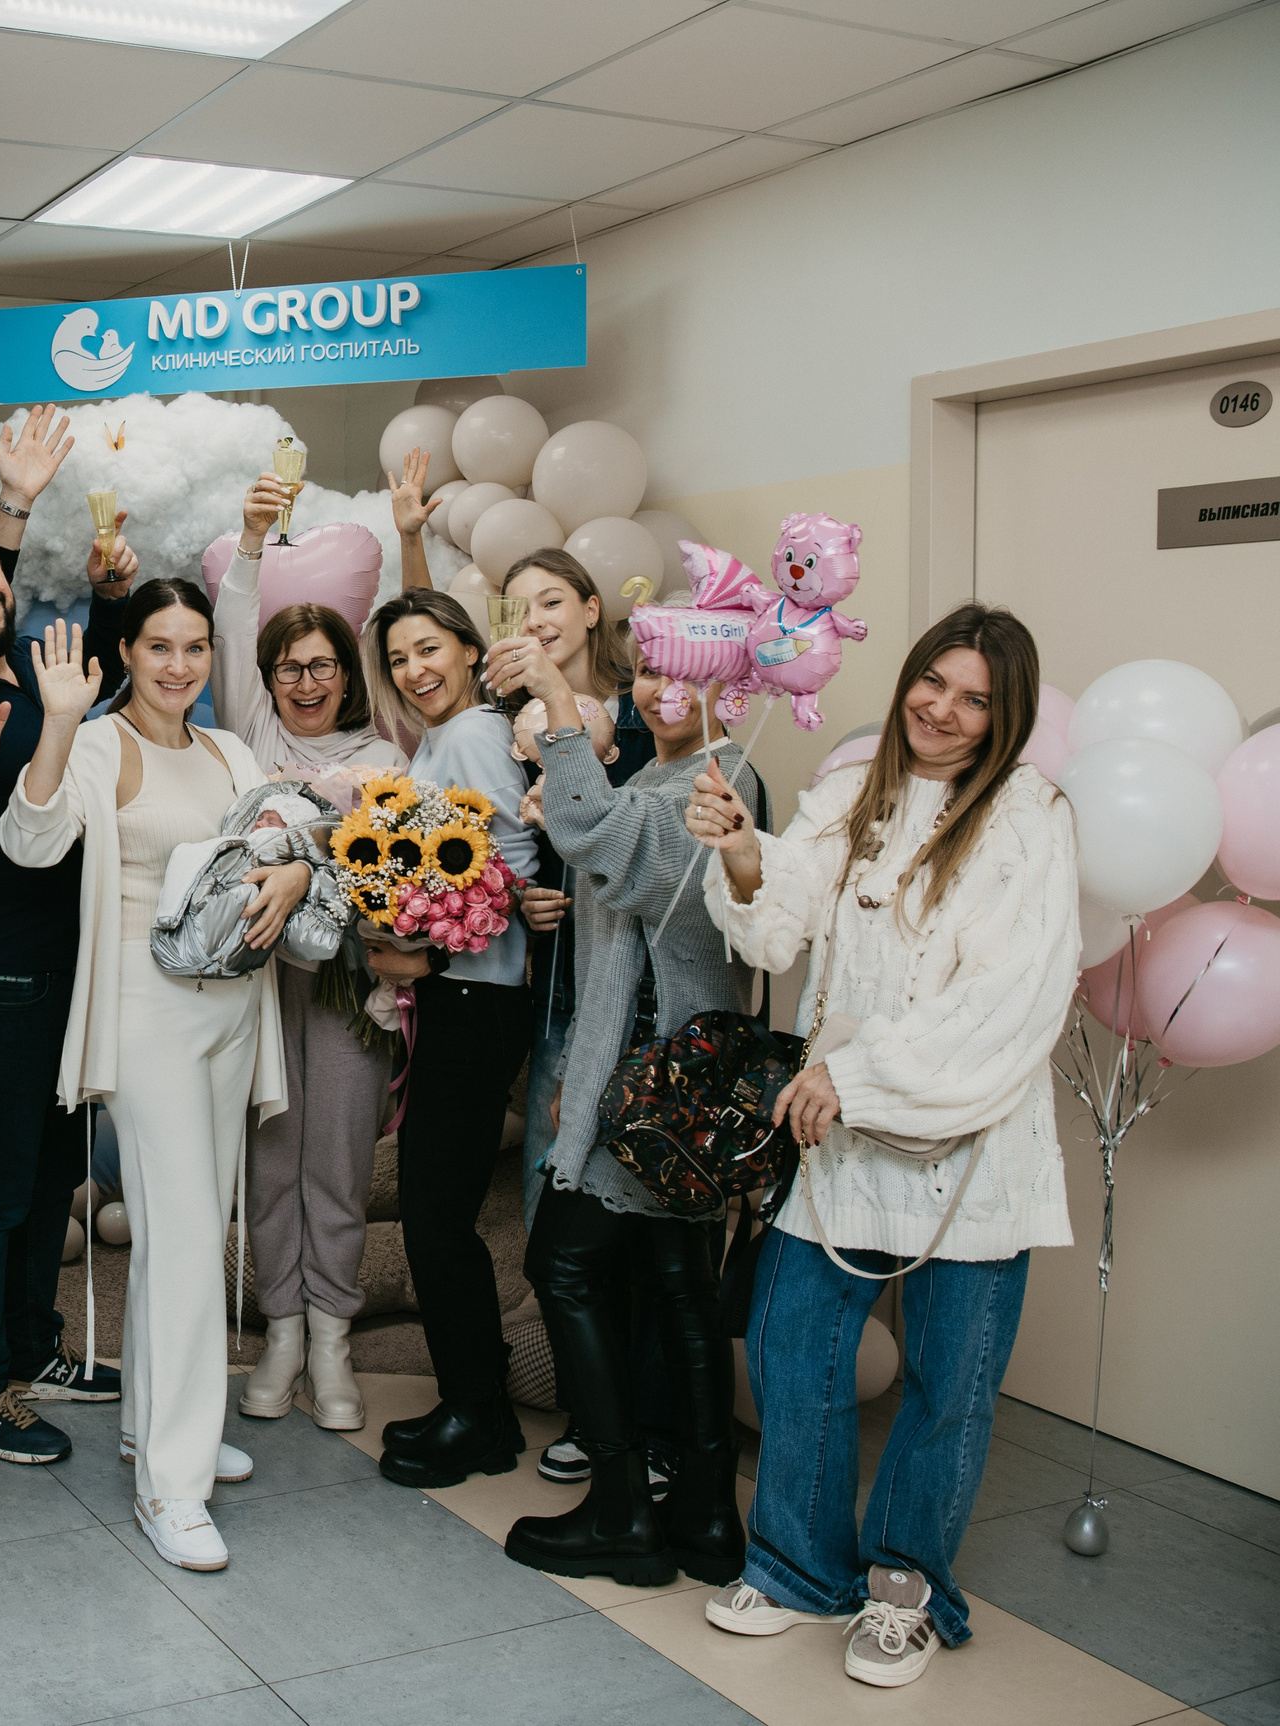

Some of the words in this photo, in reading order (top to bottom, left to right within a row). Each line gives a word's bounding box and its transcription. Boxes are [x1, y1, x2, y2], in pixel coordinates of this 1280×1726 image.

[147, 297, 230, 341] MD
[242, 282, 421, 336] GROUP
[151, 343, 295, 371] КЛИНИЧЕСКИЙ
[301, 338, 420, 361] ГОСПИТАЛЬ
[1219, 392, 1261, 415] 0146
[710, 625, 718, 636] a
[720, 624, 745, 638] Girl!
